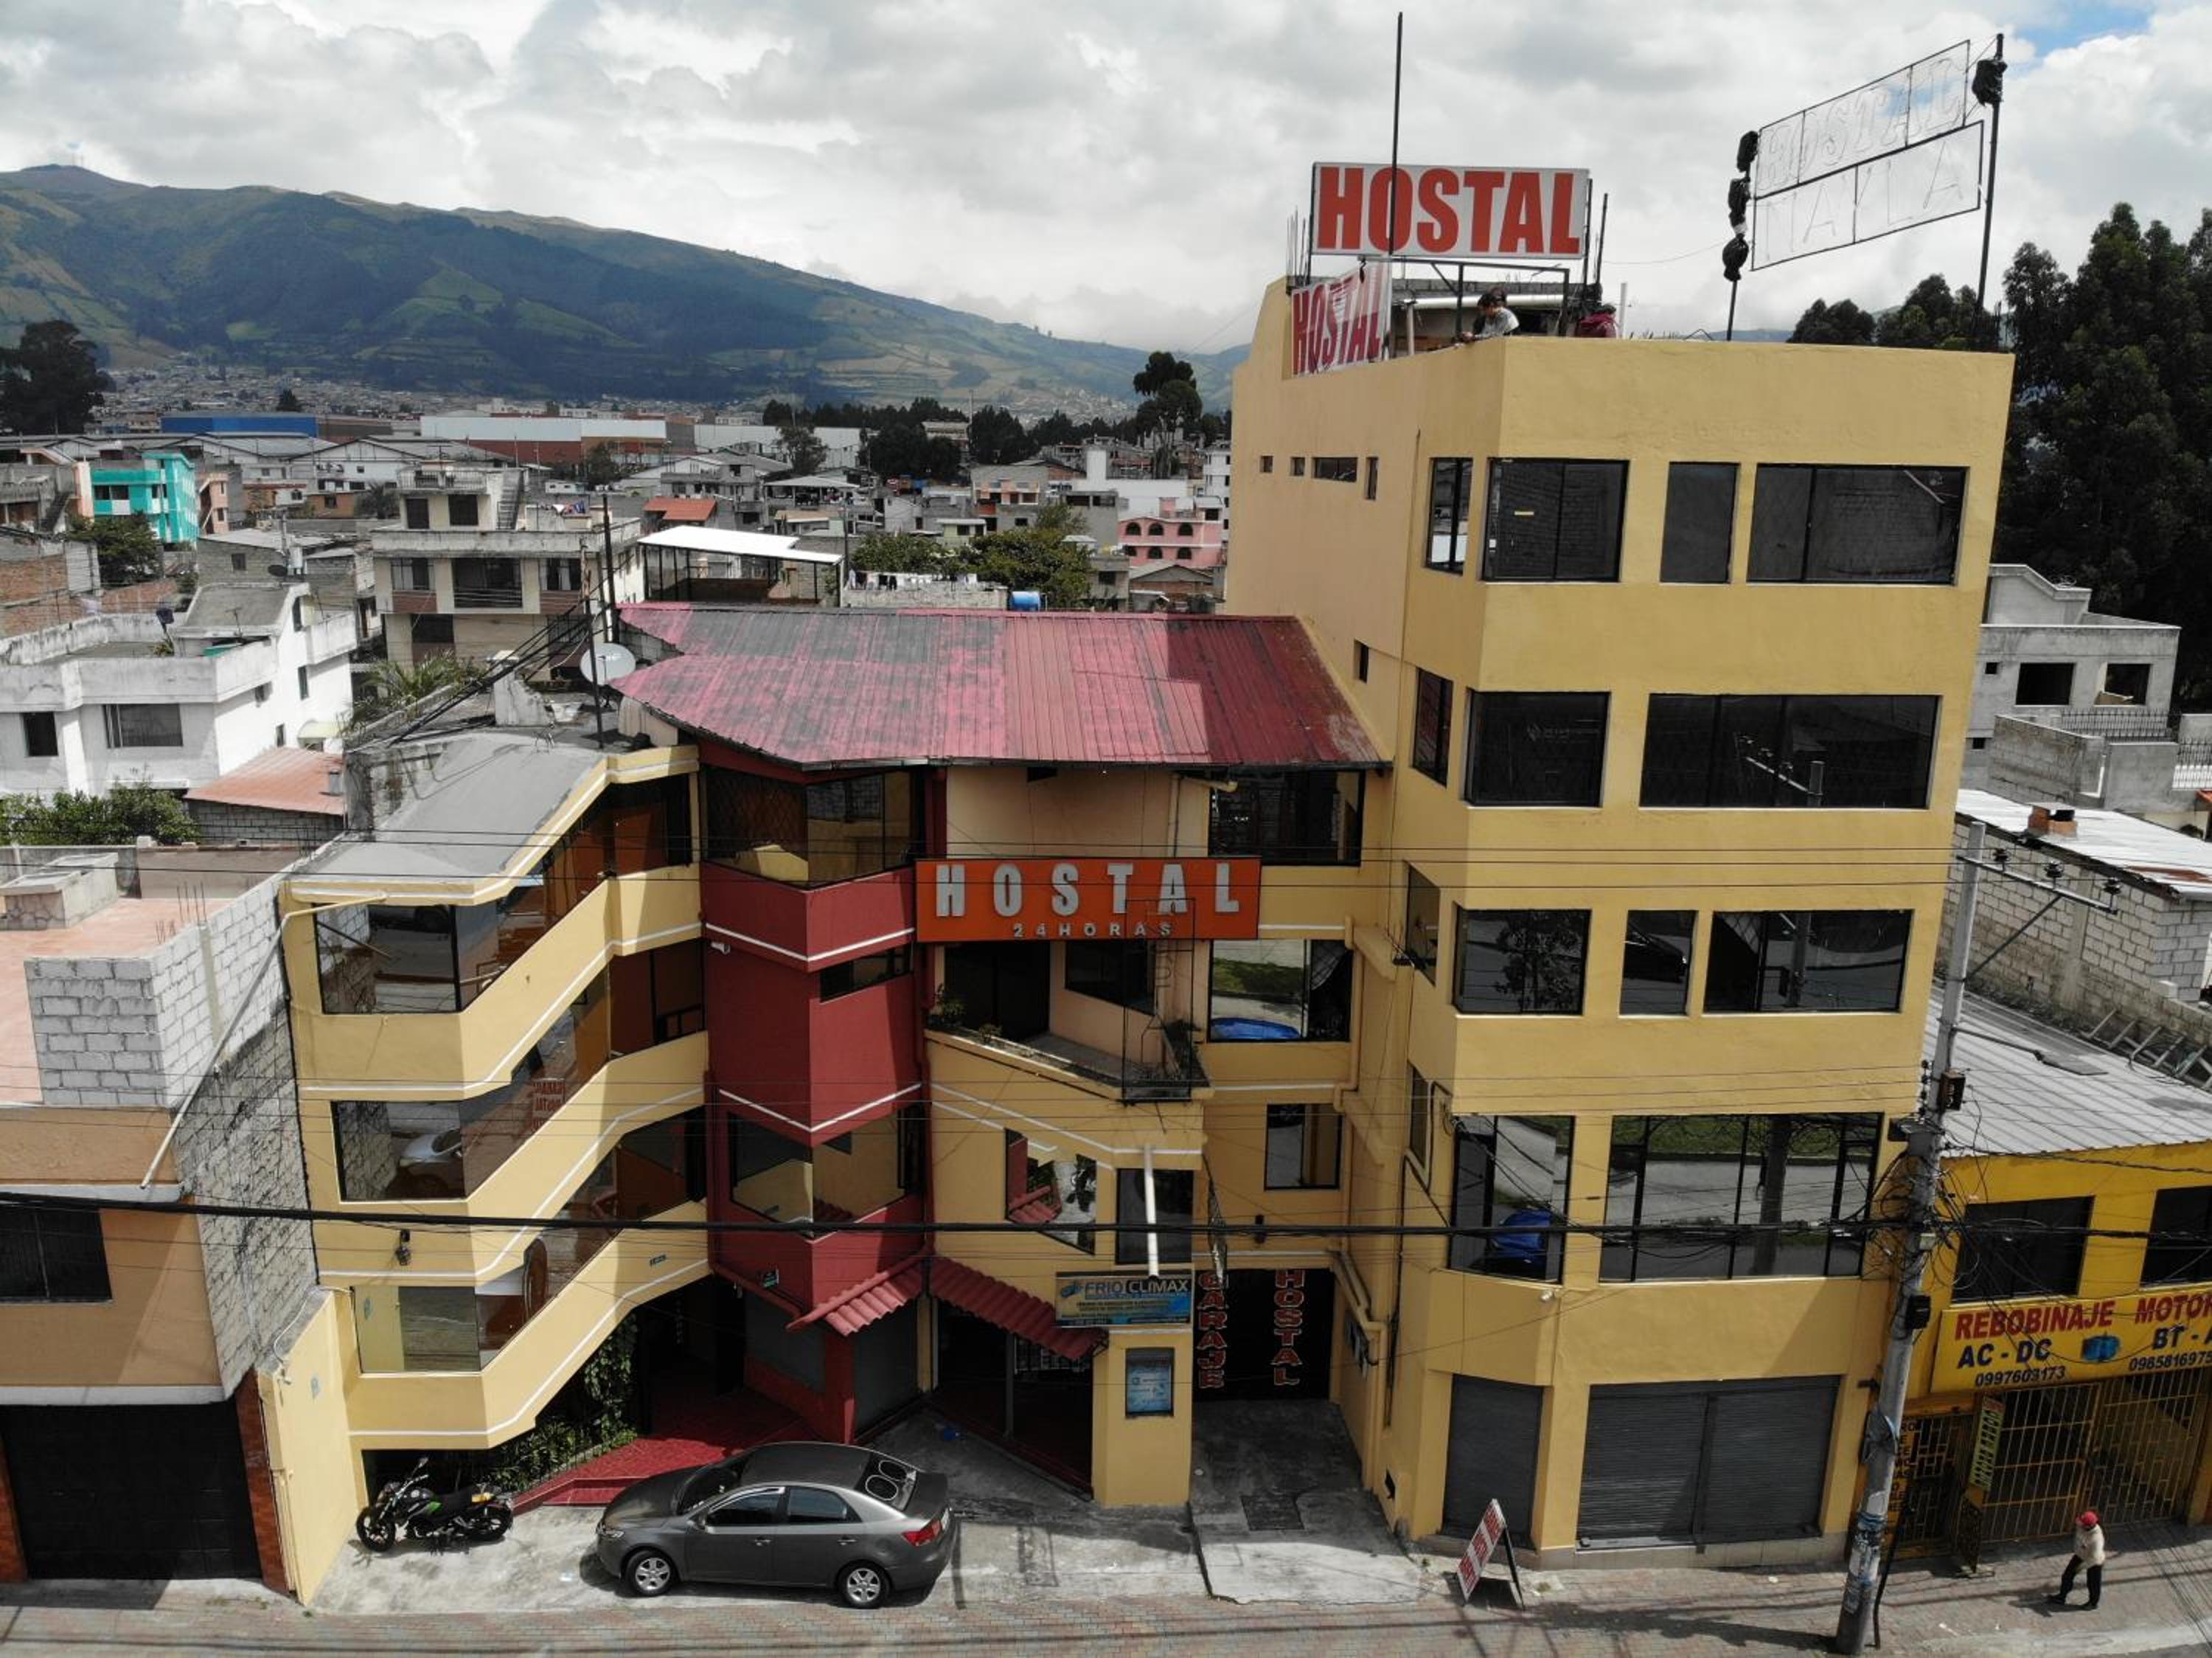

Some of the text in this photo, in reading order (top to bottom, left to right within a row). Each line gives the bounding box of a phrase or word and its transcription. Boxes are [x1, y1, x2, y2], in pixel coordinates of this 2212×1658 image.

[1318, 166, 1580, 254] HOSTAL
[1293, 262, 1383, 375] HOSTAL
[936, 862, 1239, 917] HOSTAL
[1270, 1269, 1305, 1385] HOSTAL
[1955, 1300, 2116, 1340] REBOBINAJE
